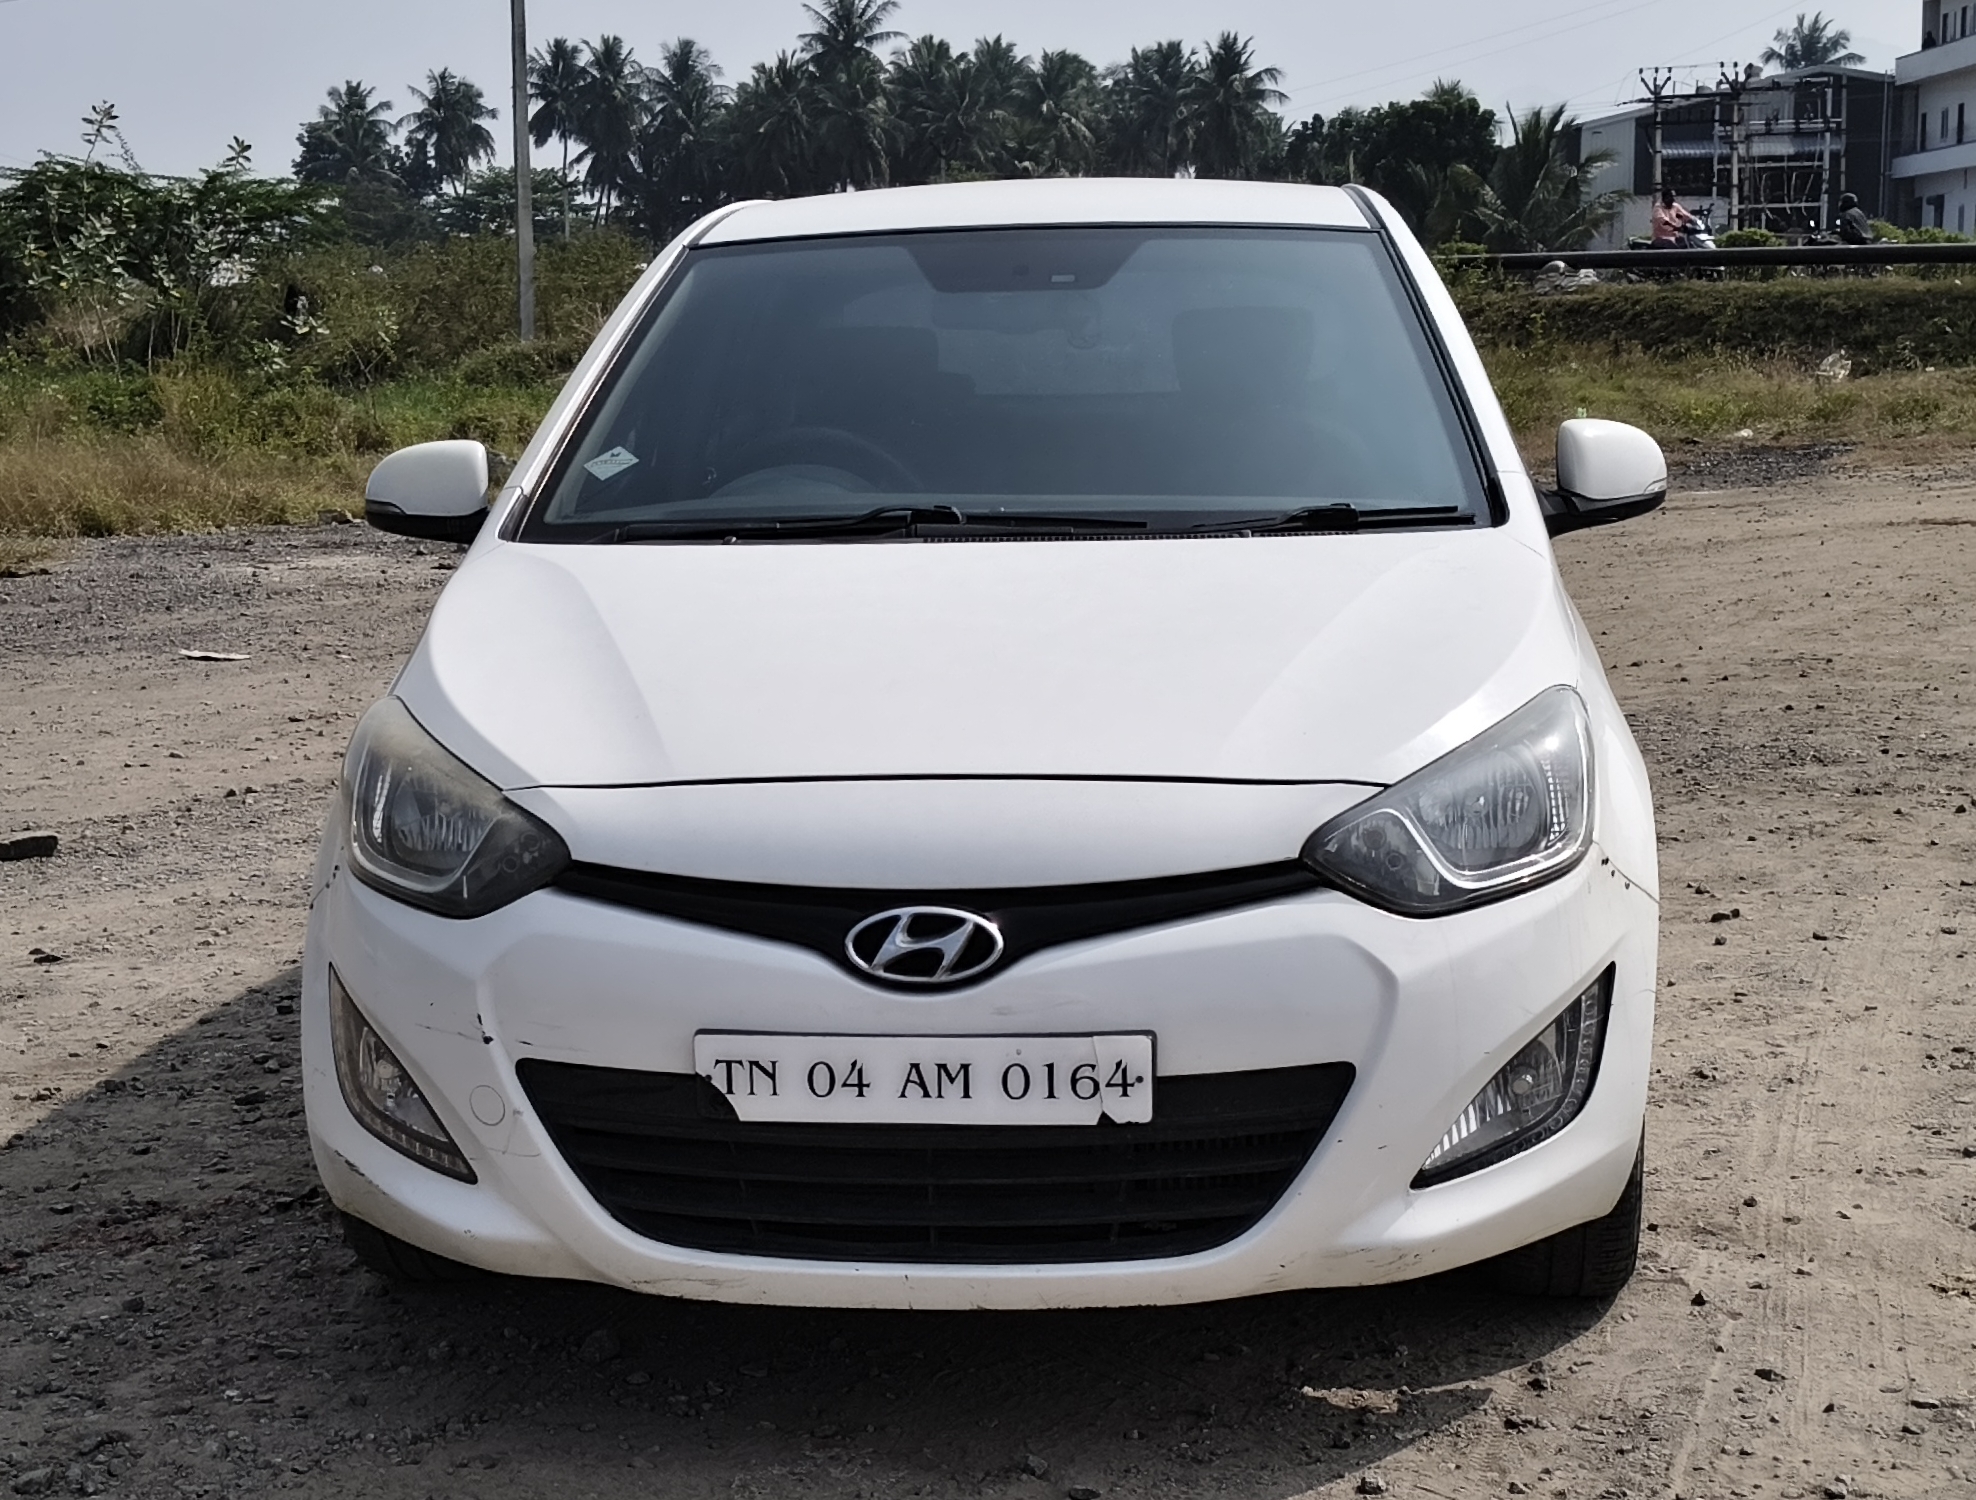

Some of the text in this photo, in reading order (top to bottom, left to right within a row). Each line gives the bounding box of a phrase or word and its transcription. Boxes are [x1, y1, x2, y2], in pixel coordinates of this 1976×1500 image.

[713, 1058, 1136, 1101] TN 04 AM 0164
